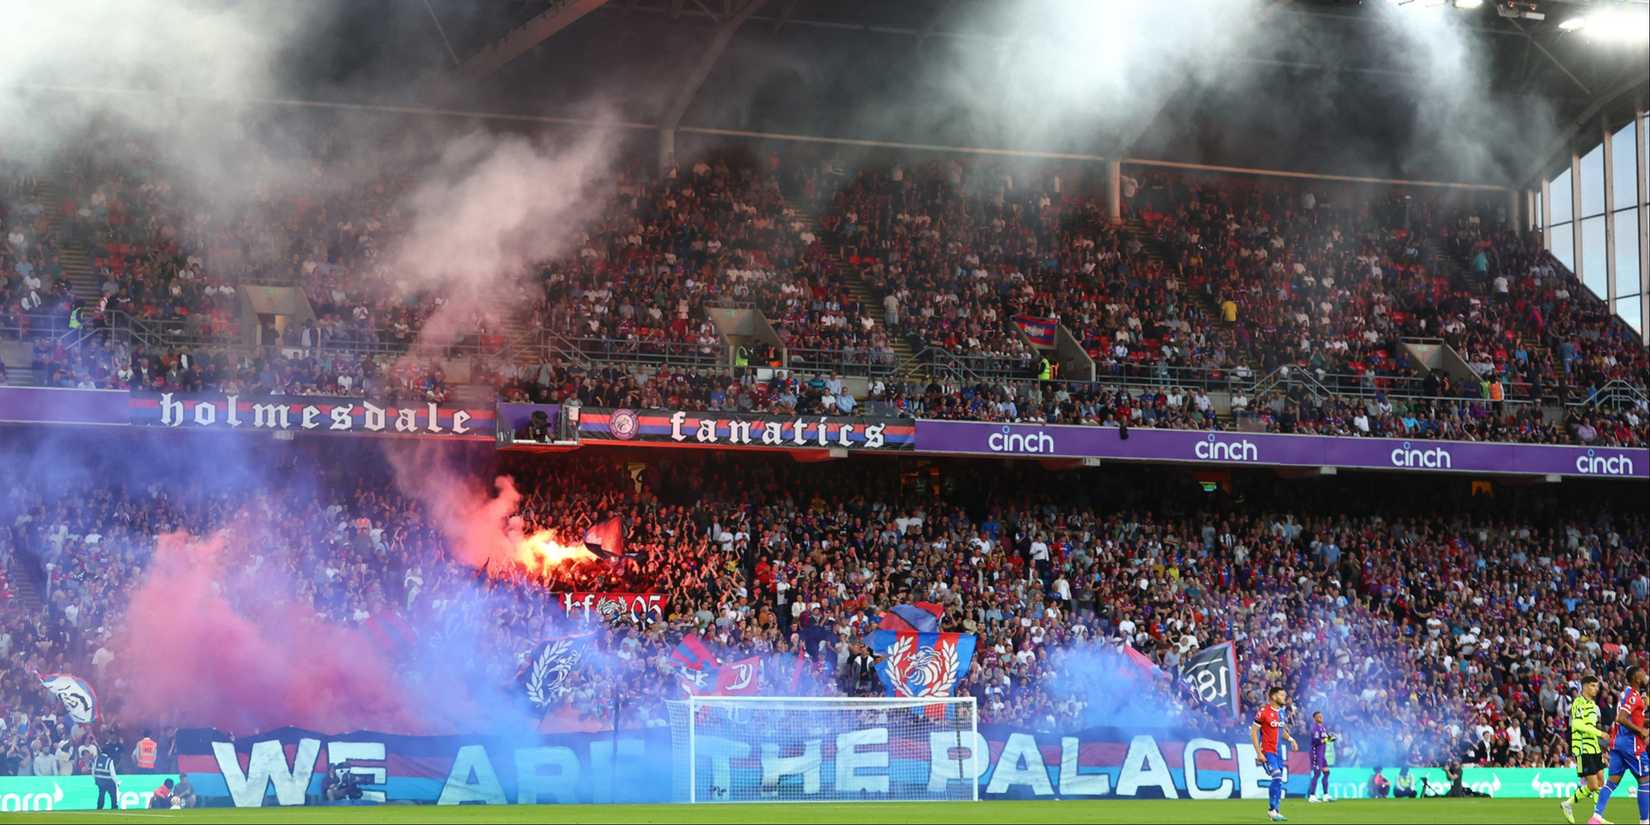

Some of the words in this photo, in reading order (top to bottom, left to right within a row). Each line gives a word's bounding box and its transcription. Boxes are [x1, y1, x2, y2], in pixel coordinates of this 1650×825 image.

[160, 392, 471, 434] holmesdale
[669, 411, 886, 448] fanatics
[988, 425, 1054, 452] cinch
[1195, 433, 1258, 461] cinch
[1391, 441, 1451, 468] cinch
[1576, 448, 1633, 474] cinch
[211, 738, 388, 808] WE
[693, 727, 890, 802] THE
[927, 727, 1288, 801] PALACE
[0, 791, 53, 812] oro
